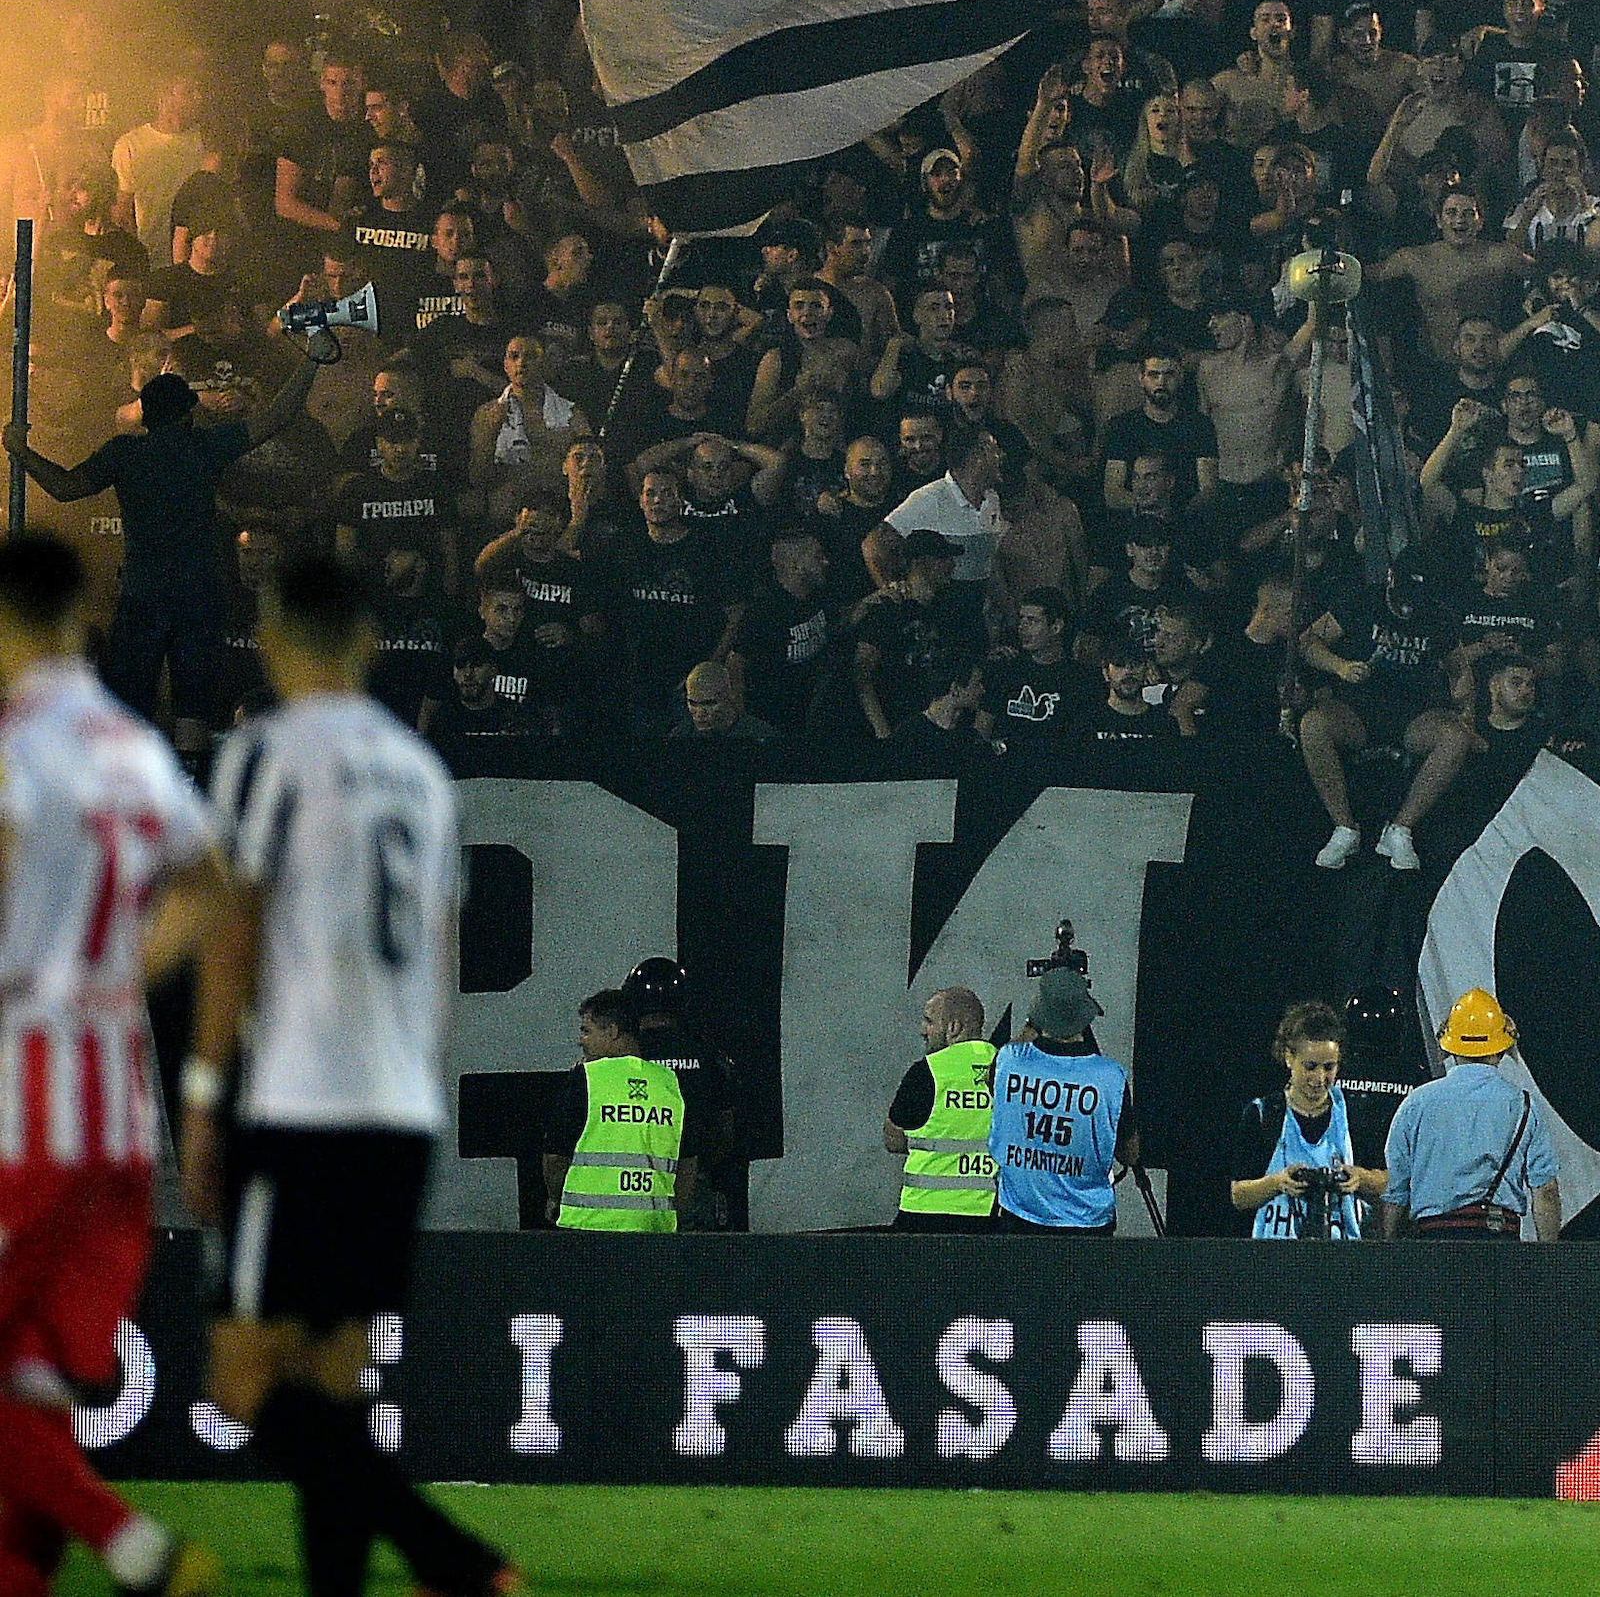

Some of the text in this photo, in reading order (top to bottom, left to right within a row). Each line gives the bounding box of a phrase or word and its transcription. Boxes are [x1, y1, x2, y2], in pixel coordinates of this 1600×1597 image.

[355, 227, 429, 251] ГРОБАРИ
[362, 499, 436, 519] ГРОБАРИ
[1006, 1074, 1099, 1116] PHOTO
[601, 1104, 674, 1127] REDAR
[1025, 1112, 1074, 1147] 145
[959, 1153, 994, 1176] 045
[1006, 1145, 1084, 1178] FC PARTIZAN
[620, 1170, 654, 1193] 035
[672, 1313, 1443, 1465] FASADE
